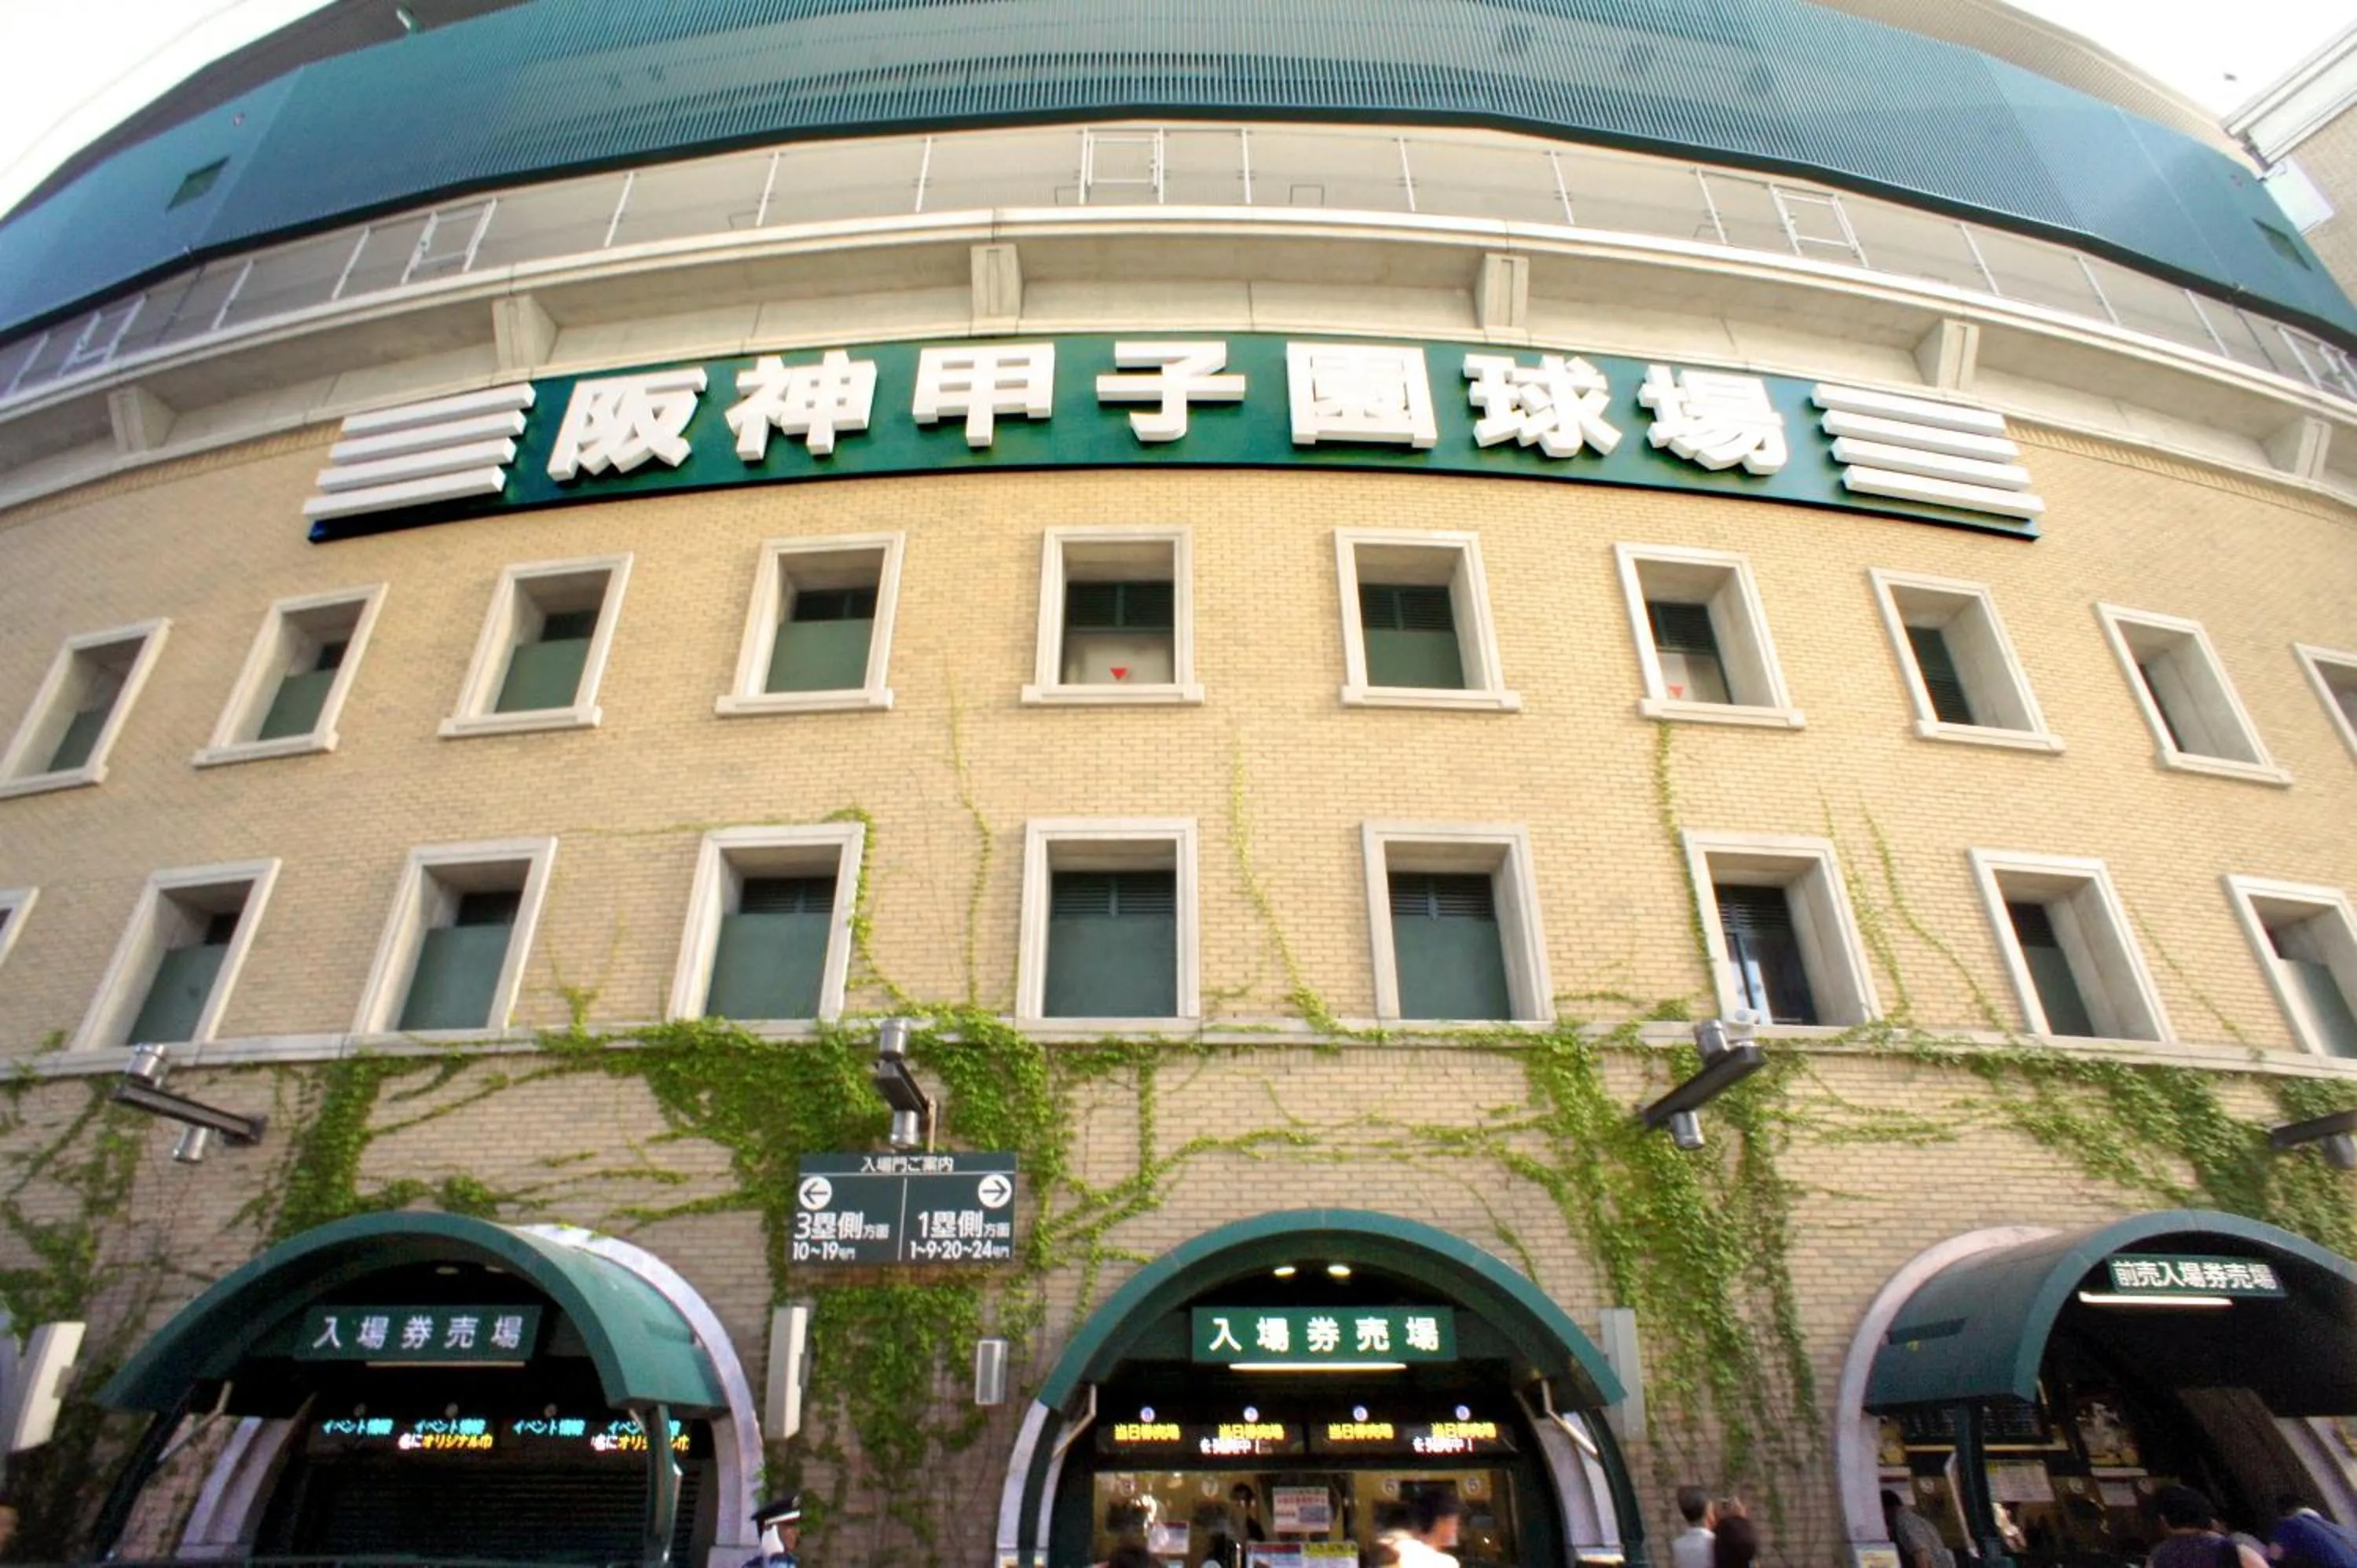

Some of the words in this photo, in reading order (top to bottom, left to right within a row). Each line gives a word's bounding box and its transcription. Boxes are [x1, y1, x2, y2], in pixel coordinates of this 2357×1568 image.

[547, 340, 1788, 480] 阪神甲子園球場
[861, 1156, 954, 1172] 入場門ご案内
[2112, 1260, 2277, 1289] 前売入場券売場
[313, 1314, 522, 1349] 入場券売場
[1209, 1317, 1439, 1351] 入場券売場
